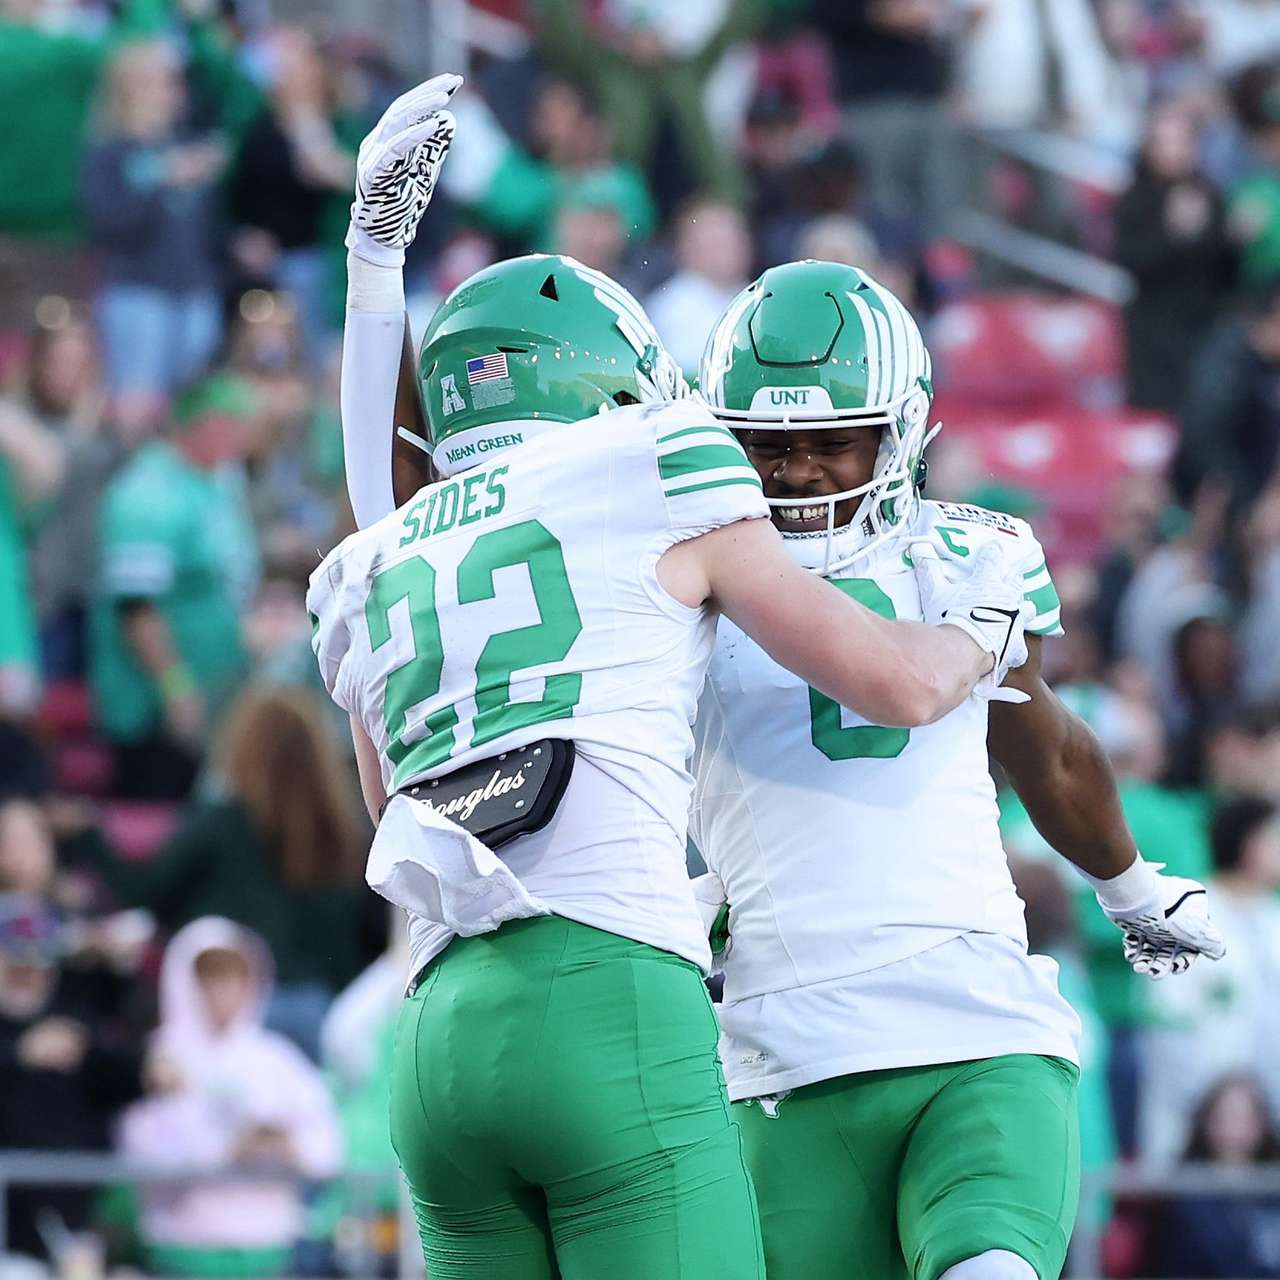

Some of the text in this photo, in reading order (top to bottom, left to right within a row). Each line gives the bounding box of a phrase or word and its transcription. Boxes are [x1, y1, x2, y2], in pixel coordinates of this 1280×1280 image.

[770, 390, 810, 405] UNT
[446, 433, 524, 464] MEAN GREEN
[398, 464, 509, 549] SIDES
[365, 518, 583, 790] 22
